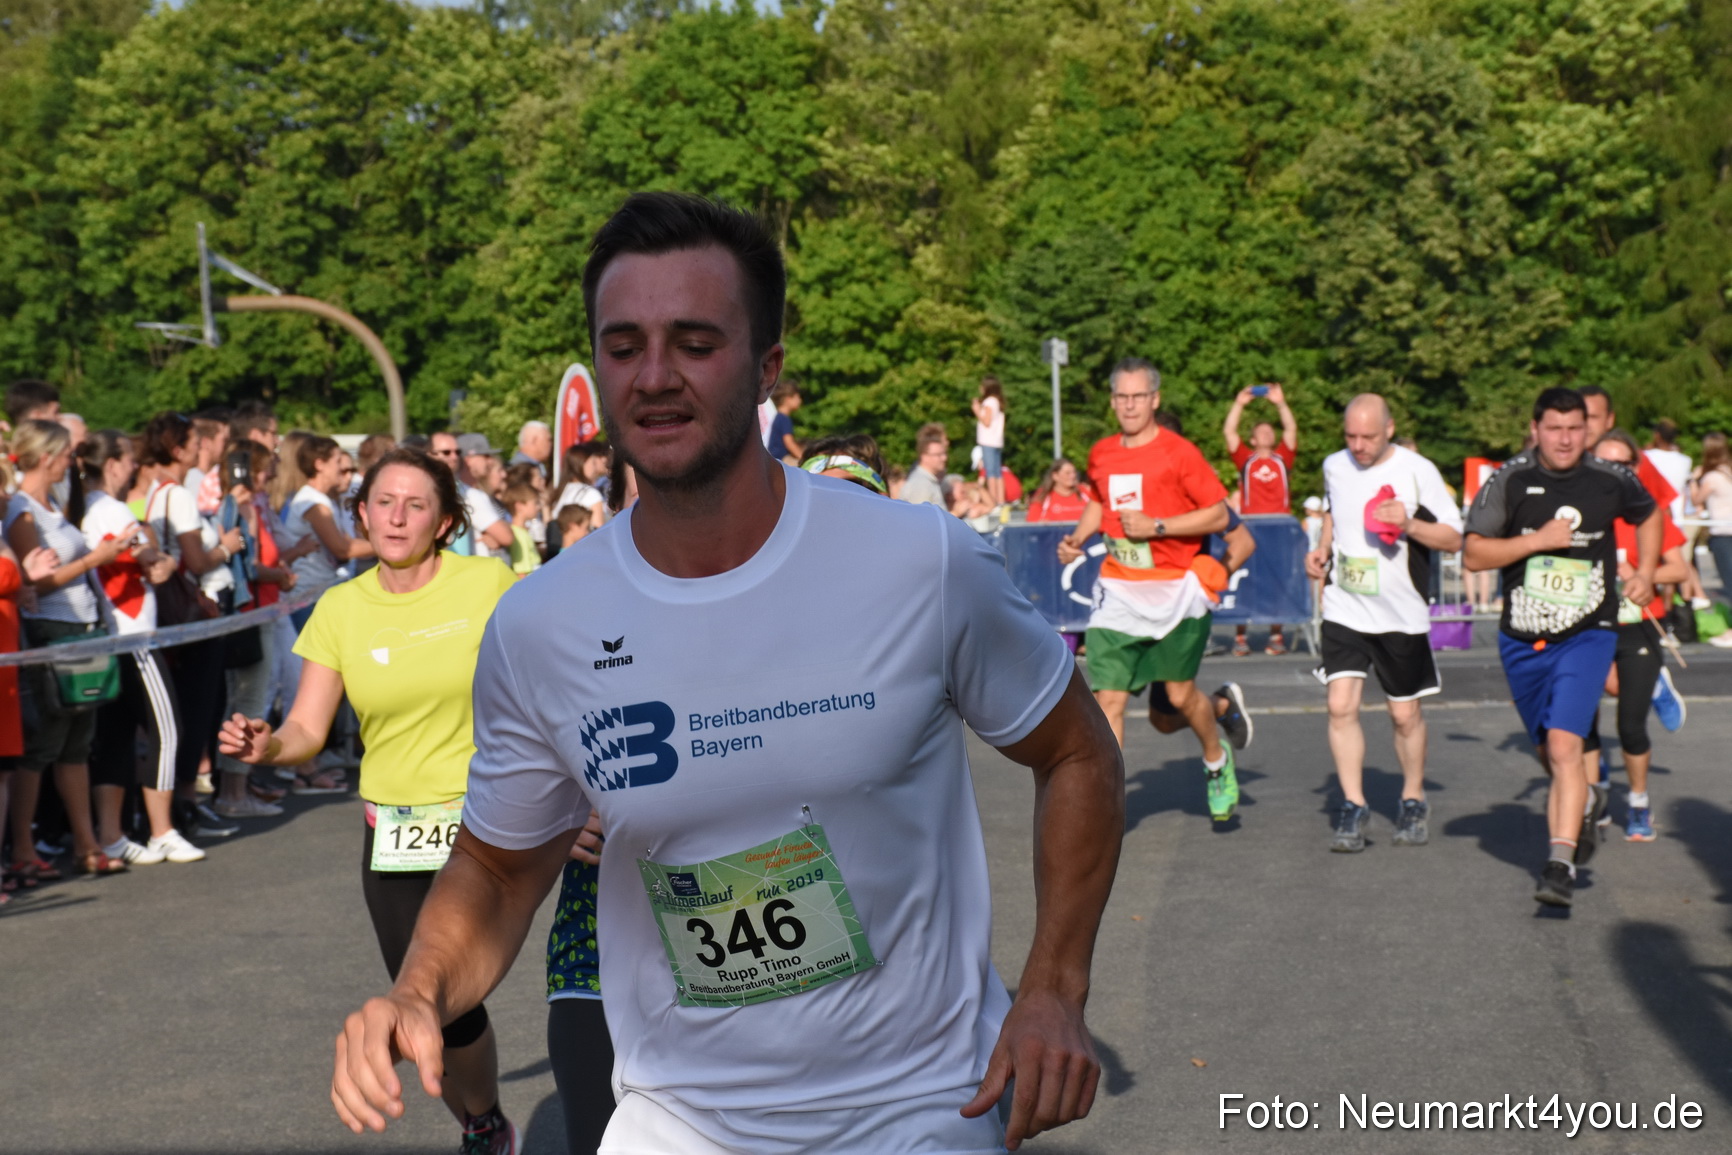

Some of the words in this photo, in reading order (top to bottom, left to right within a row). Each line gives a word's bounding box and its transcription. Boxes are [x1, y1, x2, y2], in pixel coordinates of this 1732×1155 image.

[1541, 573, 1575, 593] 103
[594, 654, 633, 670] erima
[688, 691, 876, 731] Breitbandberatung
[691, 734, 763, 758] Bayern
[389, 823, 460, 850] 1246
[745, 846, 782, 863] Gesunde
[783, 842, 813, 853] Firmen
[765, 857, 791, 870] laufen
[786, 868, 824, 893] 2019
[666, 885, 733, 907] firmenlauf
[686, 898, 807, 968] 346
[689, 977, 775, 994] Breitbandberatung
[776, 966, 814, 982] Bayern
[816, 951, 851, 970] GmbH
[717, 965, 758, 983] Rupp
[760, 955, 801, 973] Timo
